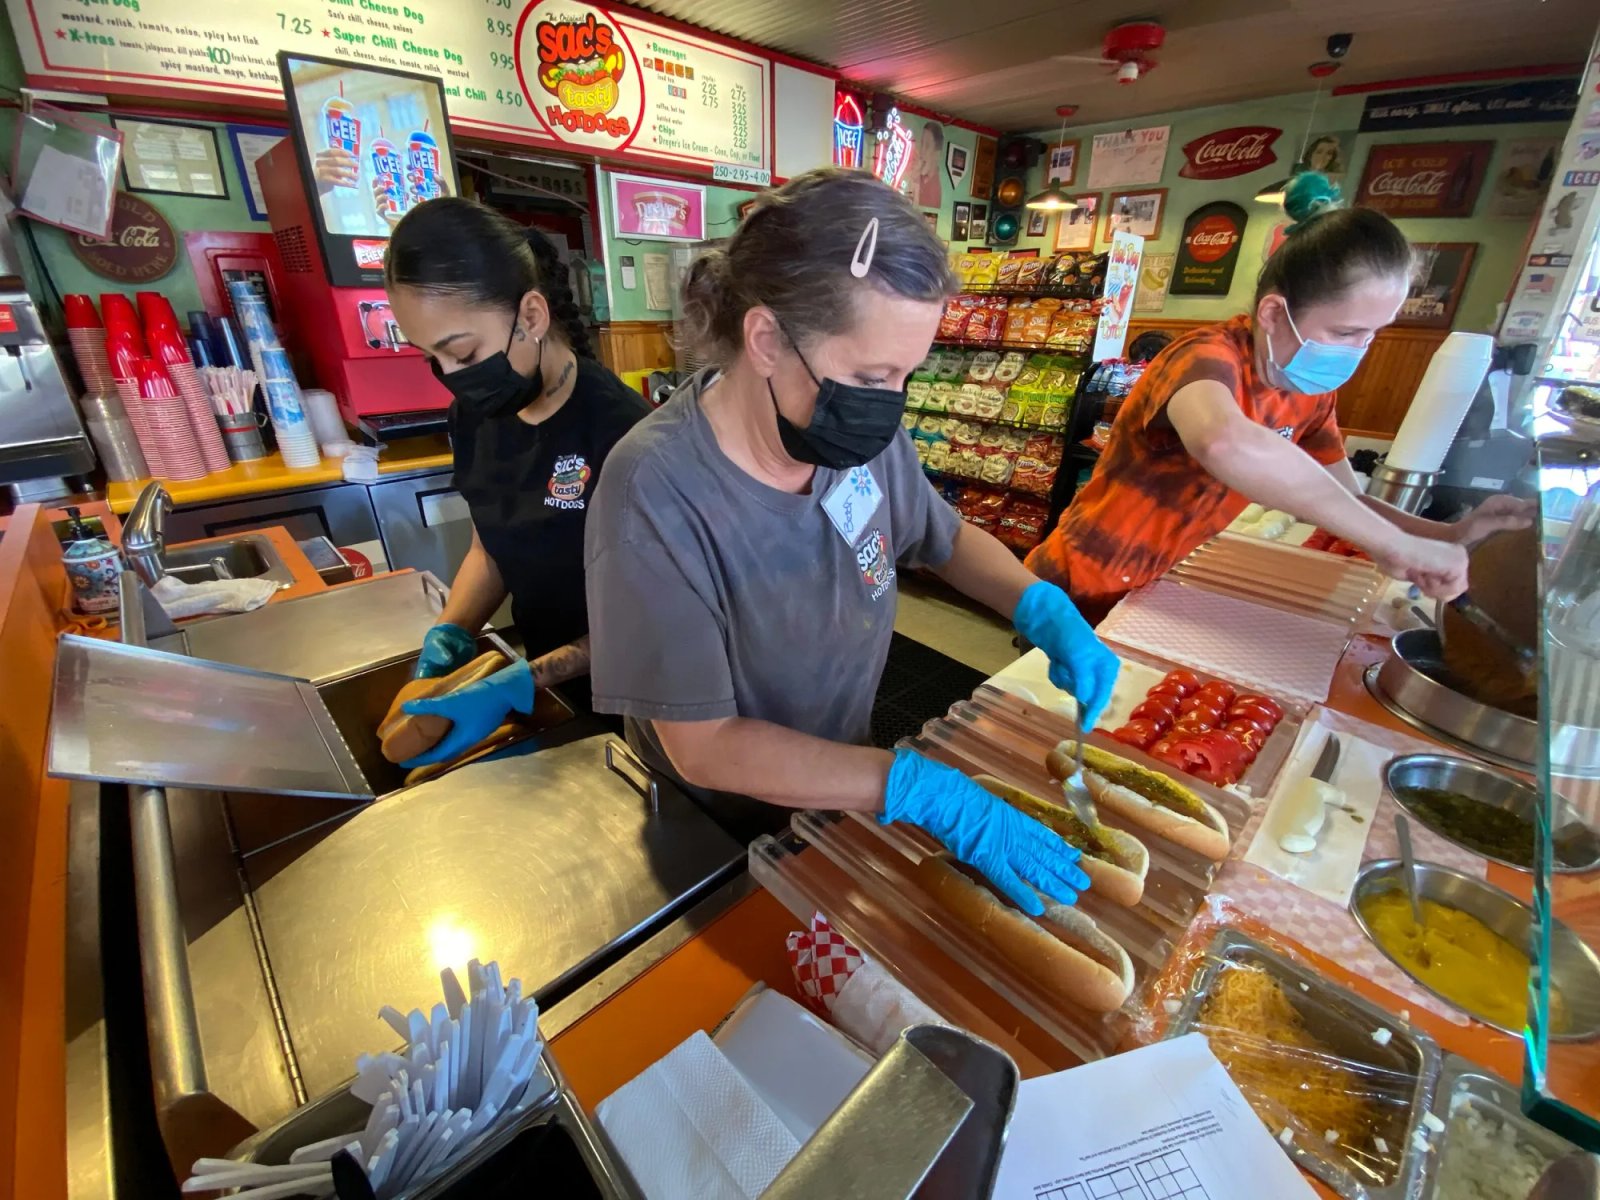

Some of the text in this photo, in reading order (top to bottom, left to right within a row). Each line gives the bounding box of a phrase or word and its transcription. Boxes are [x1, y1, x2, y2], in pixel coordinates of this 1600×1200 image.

[347, 13, 364, 25] chili,
[359, 0, 399, 16] Cheese
[403, 6, 424, 25] Dog
[138, 21, 172, 34] tomato,
[175, 25, 201, 38] onion,
[204, 30, 225, 42] spicy
[227, 32, 241, 43] hot
[243, 33, 260, 45] link
[276, 13, 313, 35] 7.25
[487, 17, 513, 38] 8.95
[68, 27, 116, 46] X-tras
[332, 26, 464, 65] Super Chili Cheese Dog
[334, 46, 351, 57] chili,
[652, 42, 687, 61] Beverages
[160, 60, 182, 72] spicy
[185, 63, 221, 75] mustard,
[223, 67, 247, 79] mayo,
[465, 87, 487, 101] Chili
[562, 81, 613, 110] tasty
[327, 118, 357, 143] ICEE
[658, 124, 676, 136] Chips
[1141, 130, 1165, 142] YOU
[682, 139, 691, 150] Ice
[692, 141, 709, 153] Cream
[1195, 132, 1272, 165] Coca-Cola
[375, 155, 402, 175] ICEE
[410, 150, 436, 171] ICEE
[1368, 170, 1451, 196] Coca-Cola
[635, 200, 687, 221] Dreyer's
[1192, 230, 1233, 246] Coca-Cola
